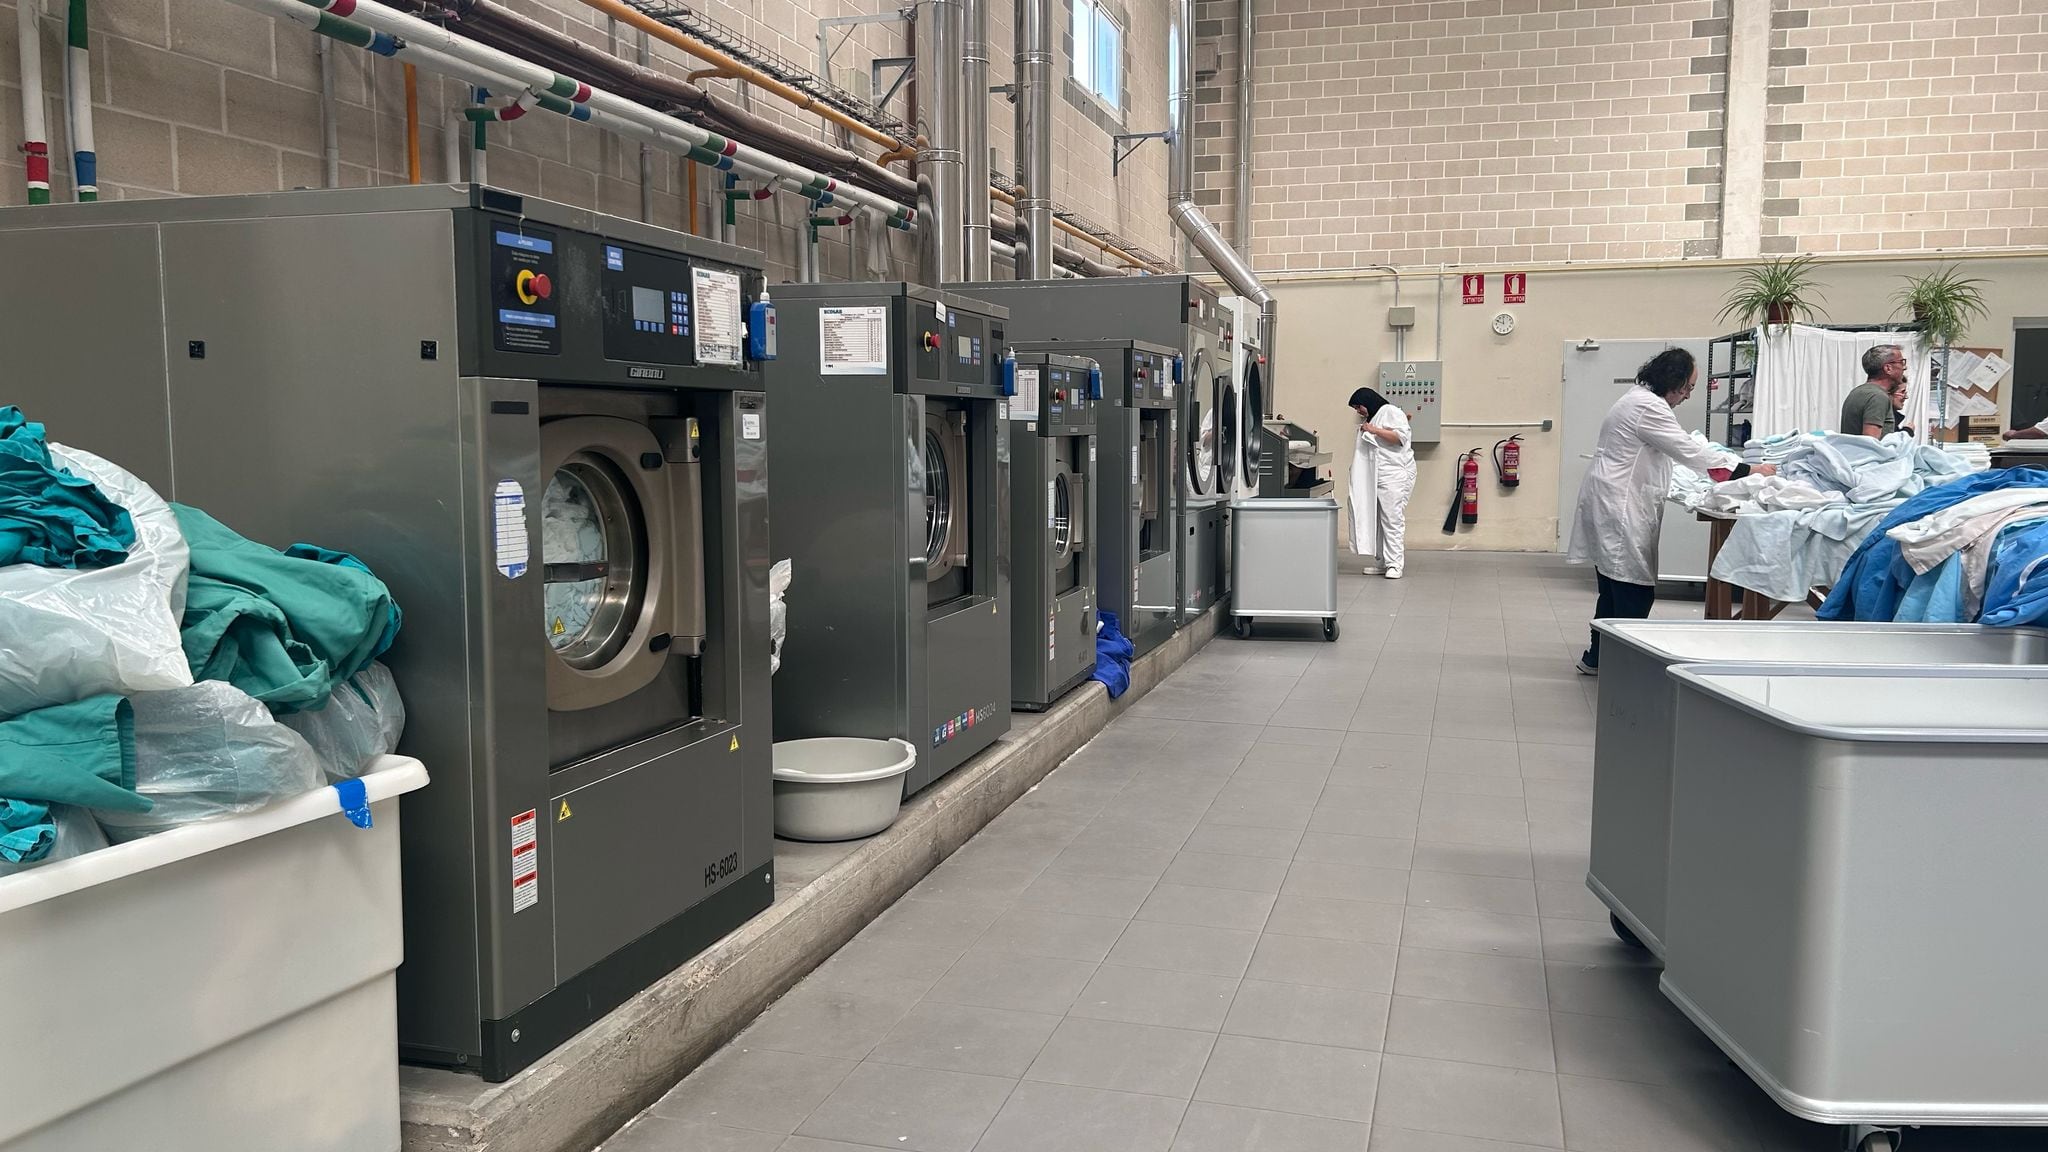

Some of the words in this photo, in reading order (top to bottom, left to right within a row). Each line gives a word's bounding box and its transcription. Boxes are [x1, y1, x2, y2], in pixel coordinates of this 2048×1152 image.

[1463, 296, 1484, 304] EXTINTOR
[1504, 295, 1525, 303] EXTINTOR
[704, 851, 738, 889] HS-6023
